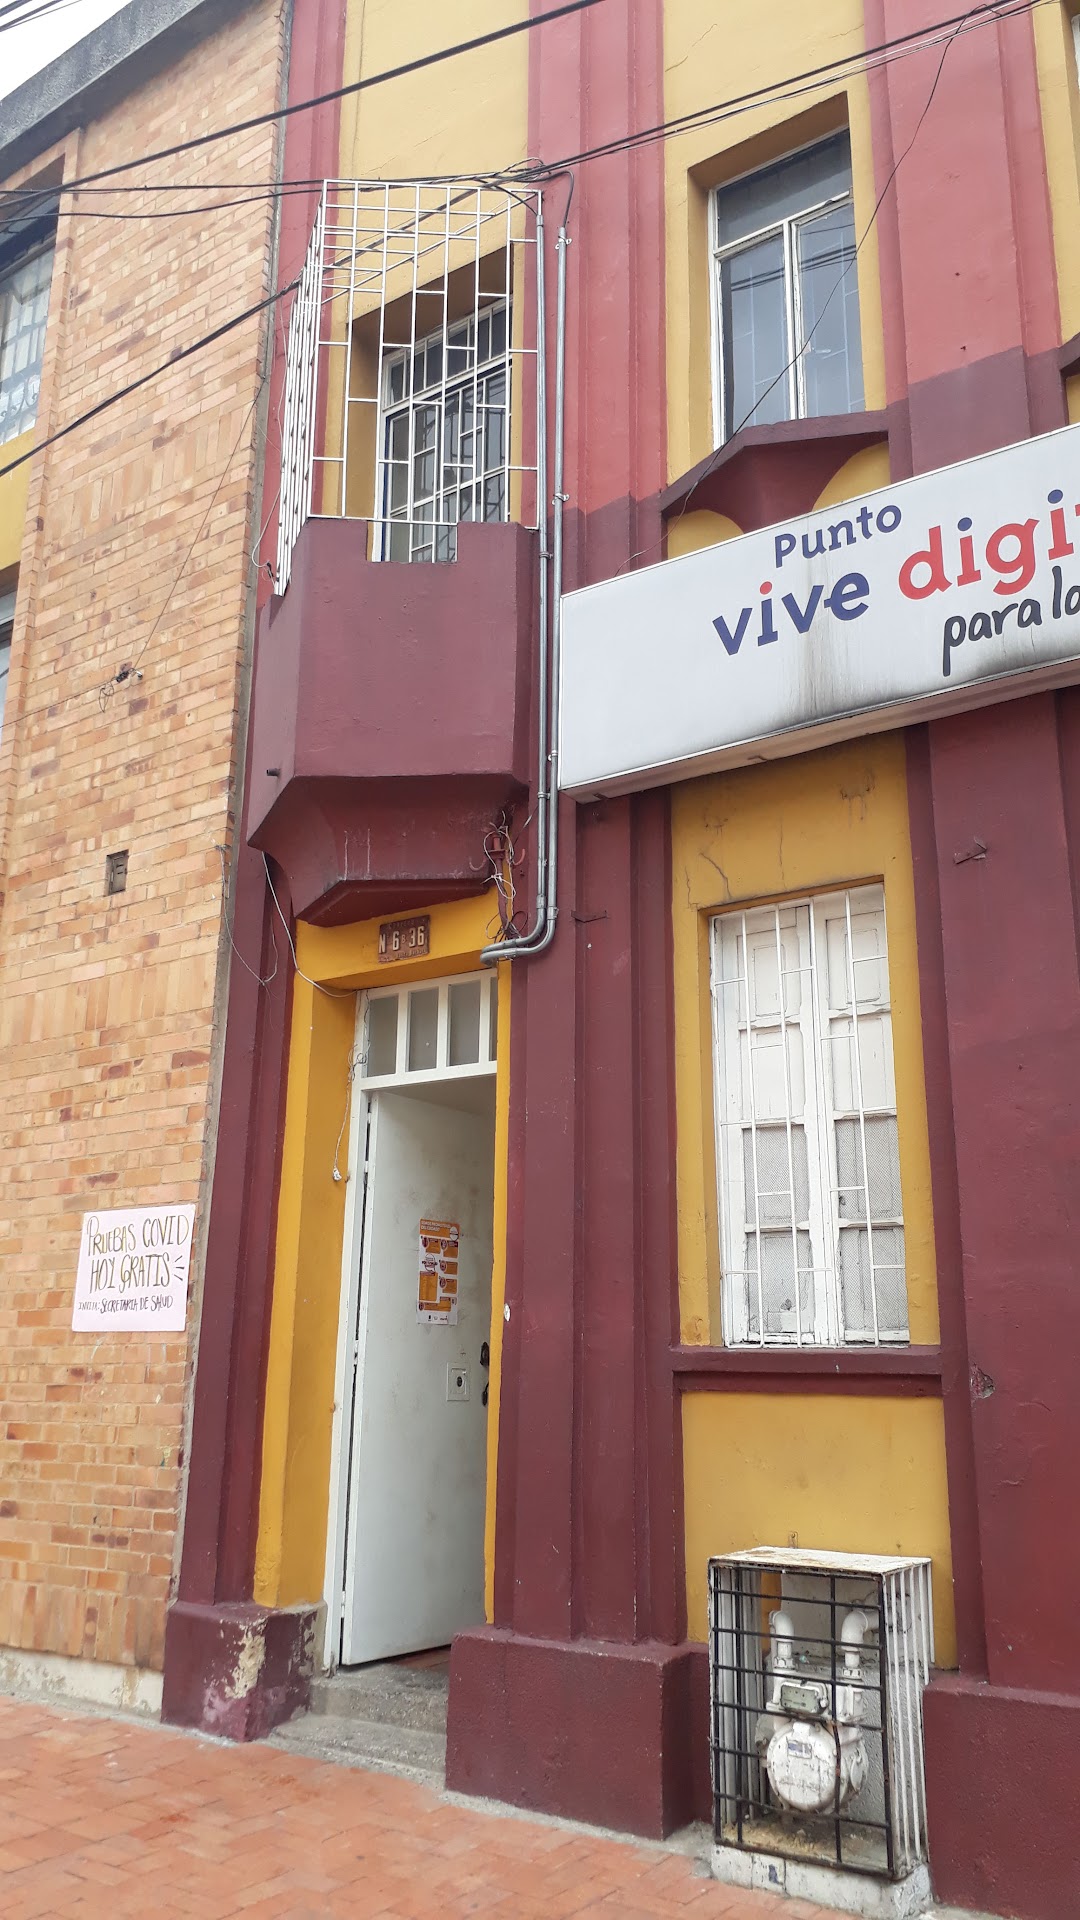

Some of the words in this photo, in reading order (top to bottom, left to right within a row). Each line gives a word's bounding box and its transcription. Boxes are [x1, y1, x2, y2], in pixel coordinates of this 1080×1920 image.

[774, 504, 902, 569] Punto
[712, 572, 870, 656] vive
[898, 489, 1080, 601] digi
[942, 598, 1043, 677] para
[87, 1215, 137, 1257] PRUEBAS
[142, 1214, 190, 1248] COVID
[89, 1257, 116, 1294] HOY
[118, 1251, 170, 1294] GRATIS
[139, 1296, 149, 1311] DE
[150, 1294, 174, 1312] SALUD
